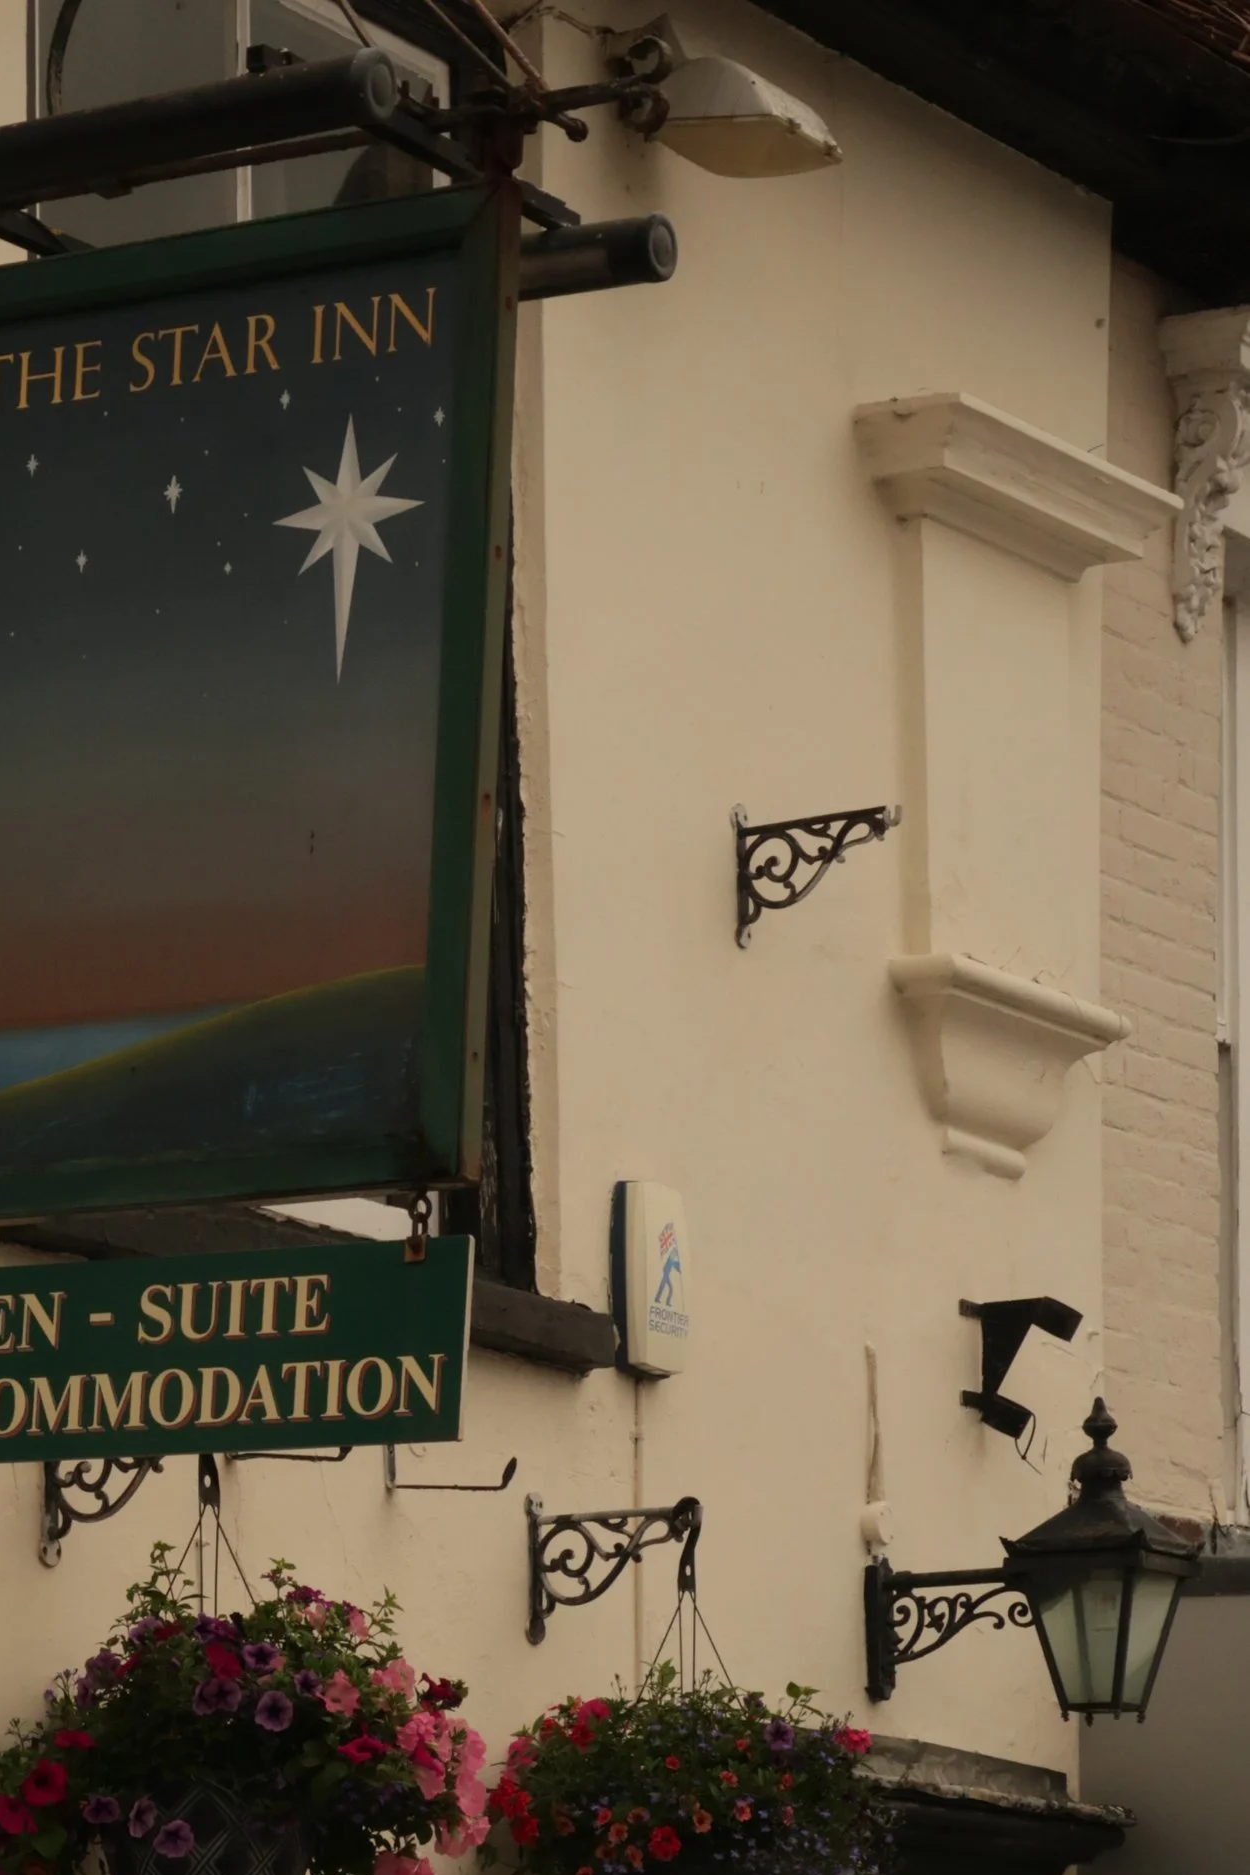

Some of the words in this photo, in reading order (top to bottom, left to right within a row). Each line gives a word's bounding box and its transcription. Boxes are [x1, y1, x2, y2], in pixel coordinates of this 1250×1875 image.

[129, 313, 282, 393] STAR
[310, 287, 437, 364] INN
[137, 1273, 333, 1346] SUITE
[649, 1306, 689, 1328] FRONTIER
[649, 1319, 688, 1339] SECURITY
